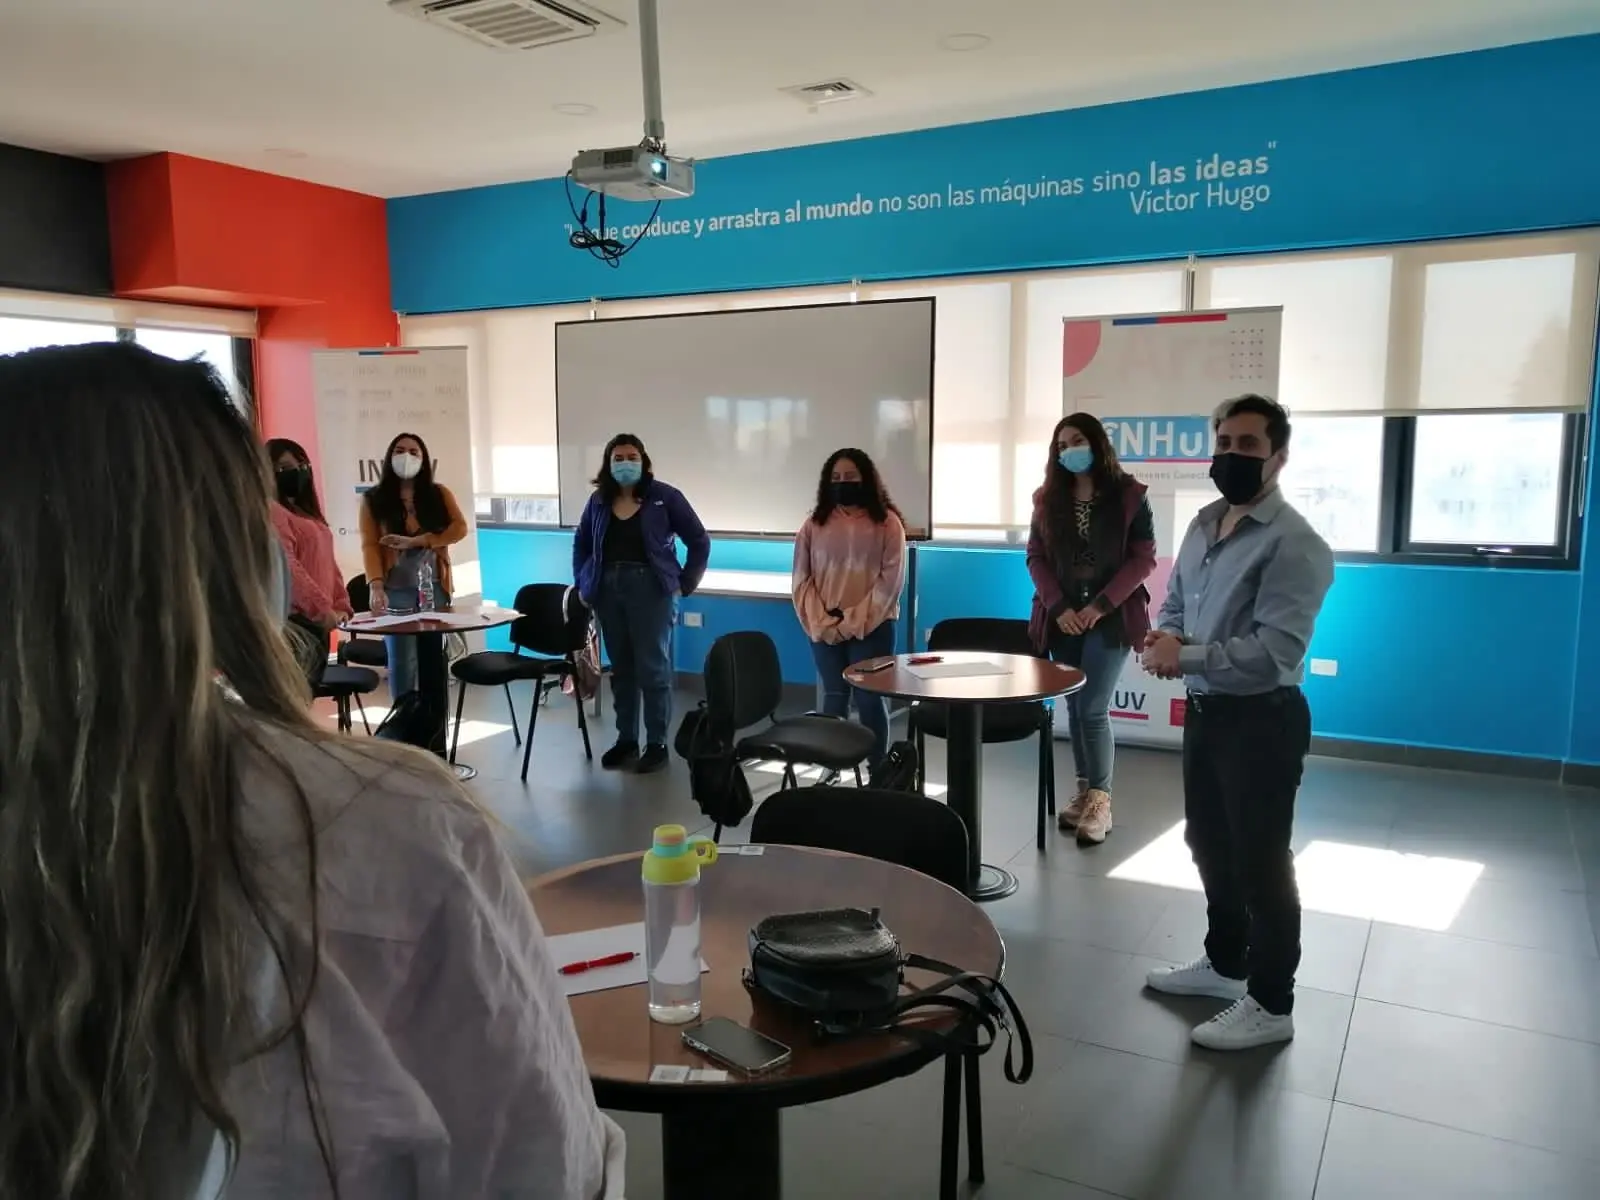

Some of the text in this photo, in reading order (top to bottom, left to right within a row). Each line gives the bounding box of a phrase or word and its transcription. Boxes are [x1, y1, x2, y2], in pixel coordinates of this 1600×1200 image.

[622, 214, 690, 239] conduce
[693, 218, 705, 238] y
[708, 207, 781, 231] arrastra
[785, 199, 801, 222] al
[806, 192, 873, 220] mundo
[878, 195, 902, 213] no
[907, 192, 941, 211] son
[948, 183, 975, 206] las
[980, 175, 1084, 207] máquinas
[1093, 170, 1141, 192] sino
[1150, 161, 1186, 185] las
[1130, 181, 1271, 214] Víctor Hugo
